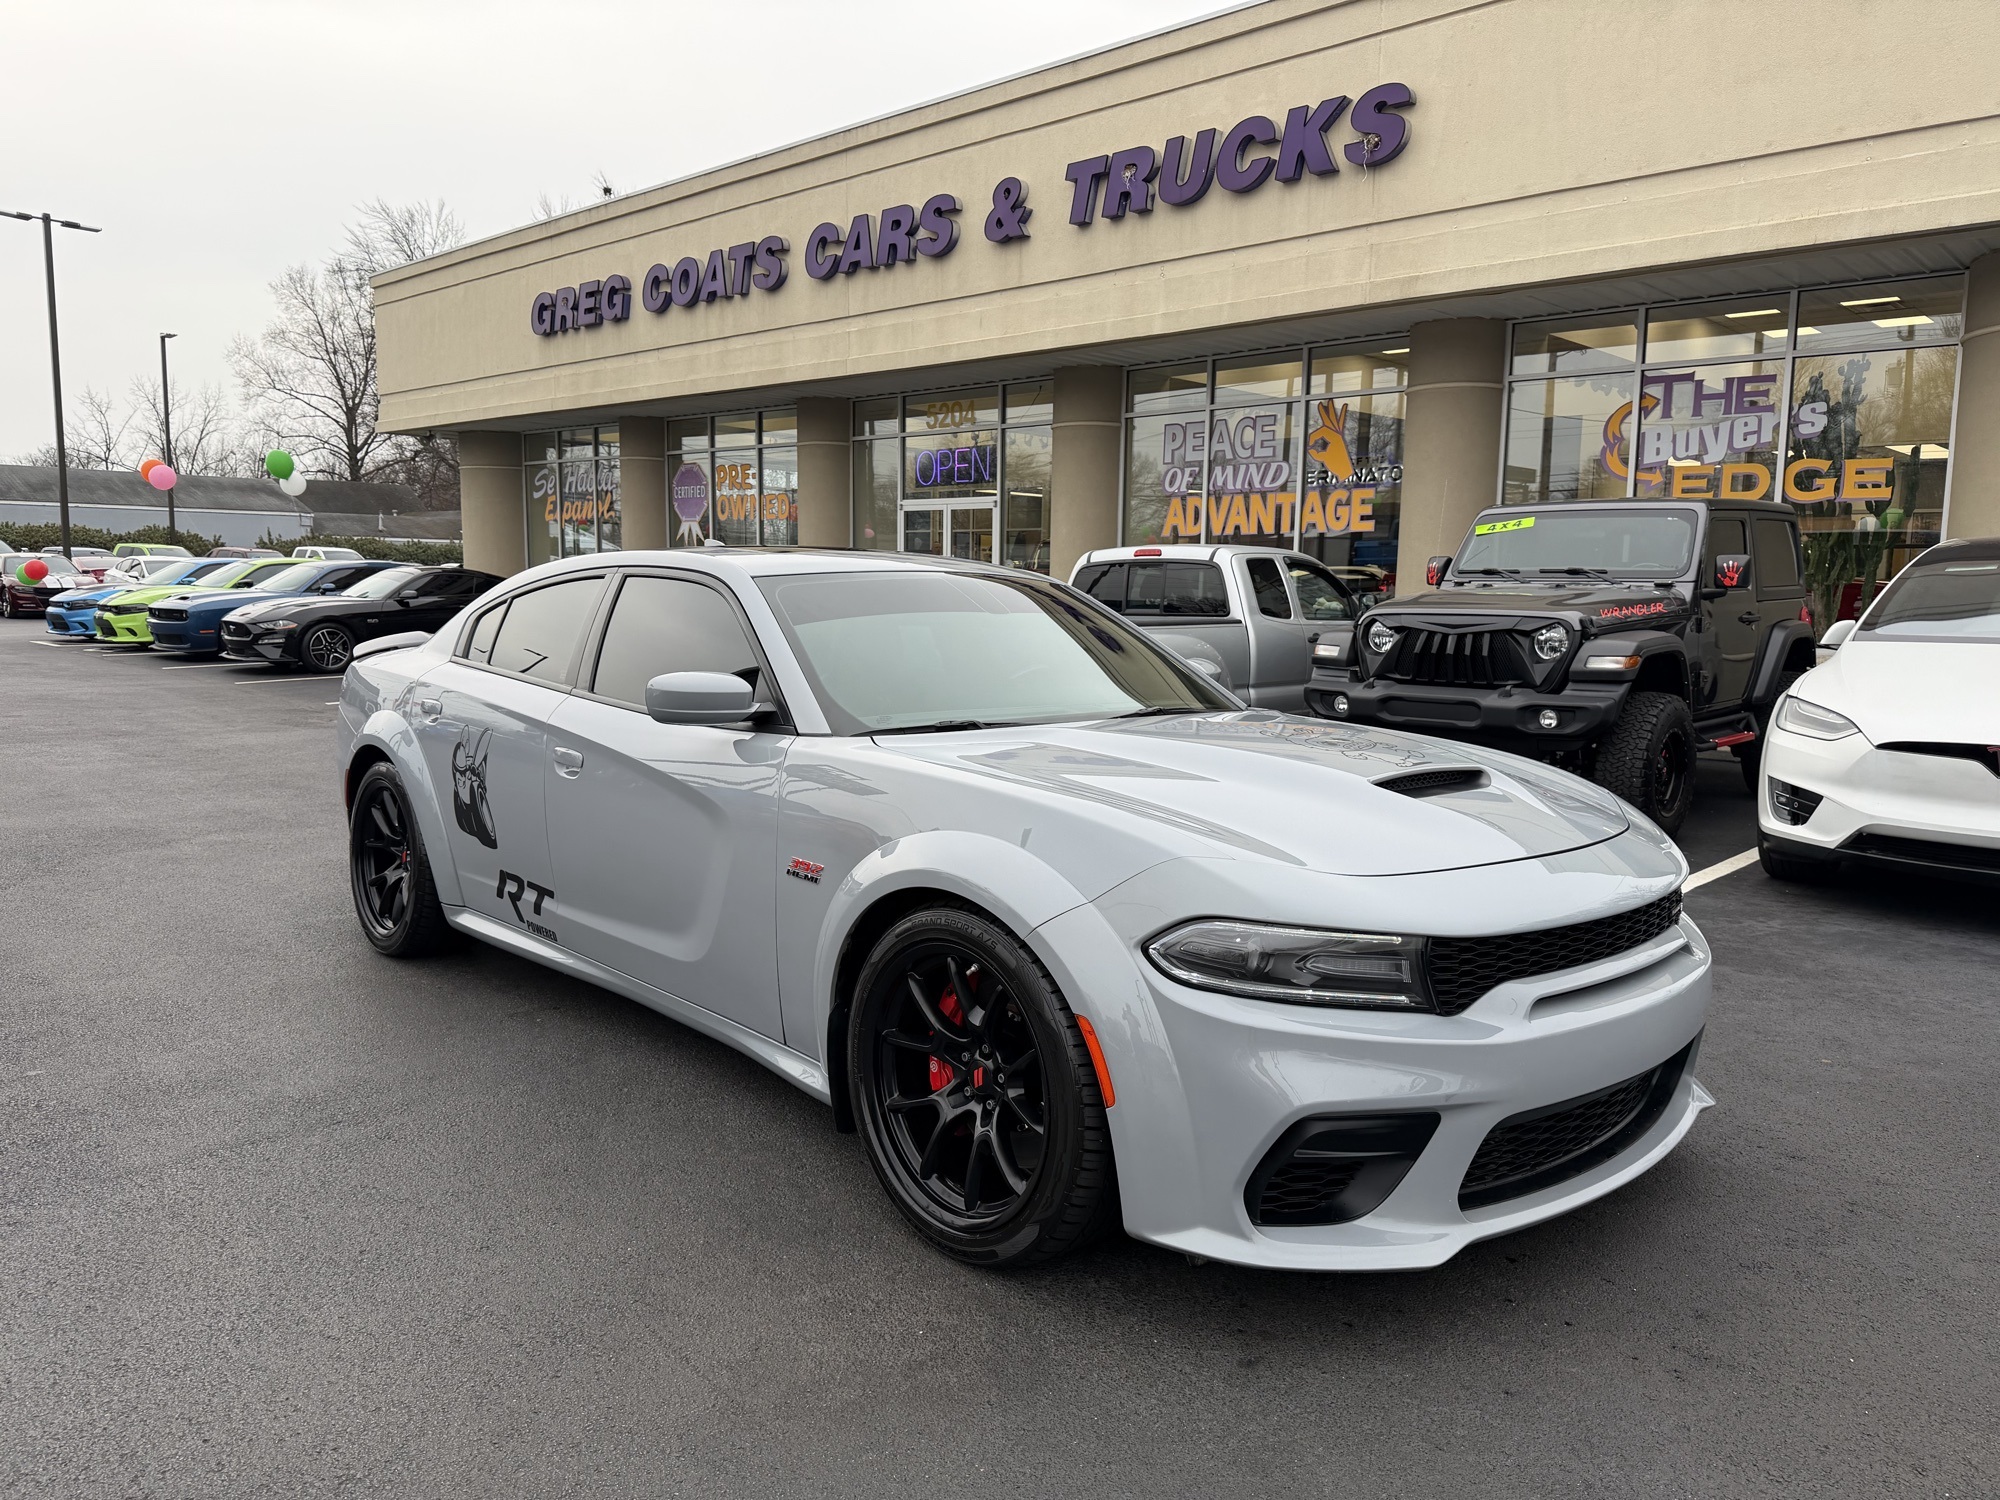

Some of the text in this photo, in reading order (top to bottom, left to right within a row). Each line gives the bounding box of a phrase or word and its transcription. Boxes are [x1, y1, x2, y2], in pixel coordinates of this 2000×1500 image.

[531, 82, 1416, 336] GREG COATS CARS & TRUCKS
[1643, 371, 1778, 420] THE
[925, 400, 977, 429] 5204
[1163, 414, 1277, 465] PEACE
[1638, 400, 1828, 470] Buyer's
[716, 463, 757, 491] PRE-
[916, 446, 990, 486] OPEN
[1163, 461, 1290, 493] OF MIND
[1671, 457, 1894, 503] EDGE
[532, 468, 556, 499] Se
[674, 485, 706, 499] CERTIFIED
[716, 493, 789, 521] OWNED
[1161, 487, 1376, 537] ADVANTAGE
[1600, 602, 1668, 618] WRANGLER
[786, 868, 821, 885] HEMI
[496, 869, 555, 924] RT
[526, 919, 558, 942] POWERED
[943, 918, 976, 935] SPORT
[977, 933, 998, 950] A/S
